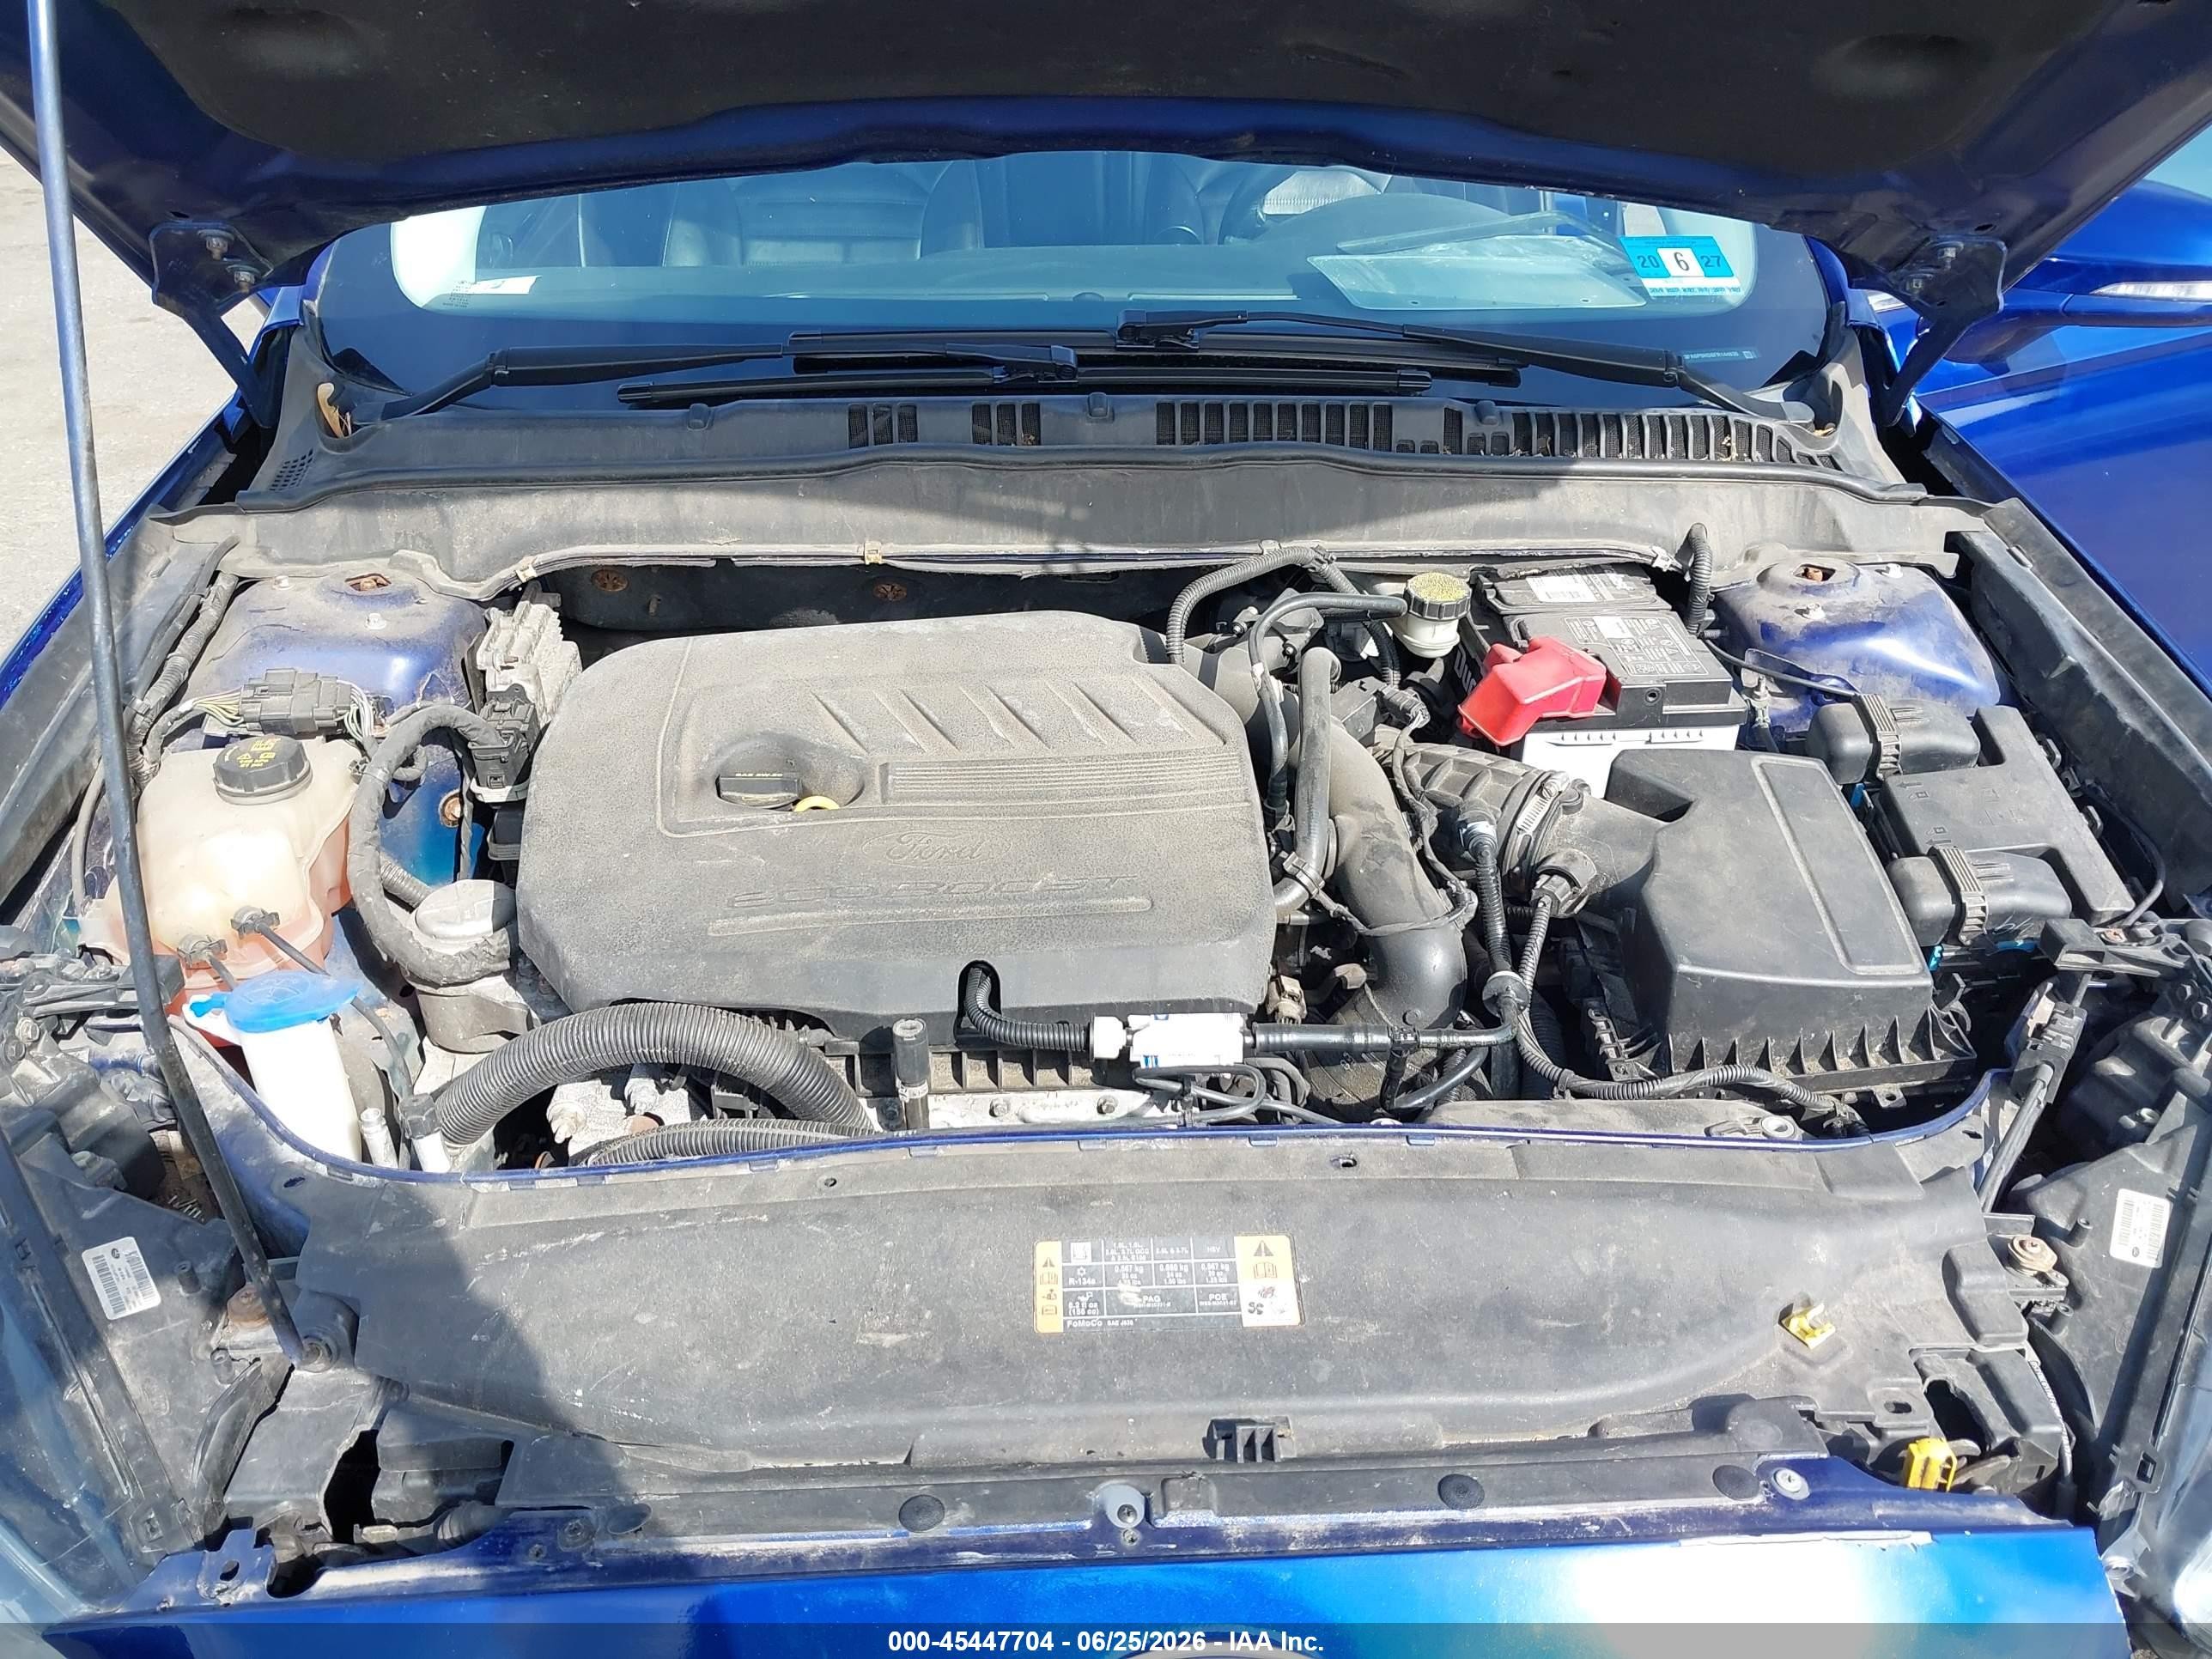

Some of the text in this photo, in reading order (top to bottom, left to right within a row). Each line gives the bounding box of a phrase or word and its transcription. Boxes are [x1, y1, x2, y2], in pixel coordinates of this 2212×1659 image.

[1637, 252, 1723, 271] 20 6 27
[1066, 1319, 1103, 1328] FoMoCo
